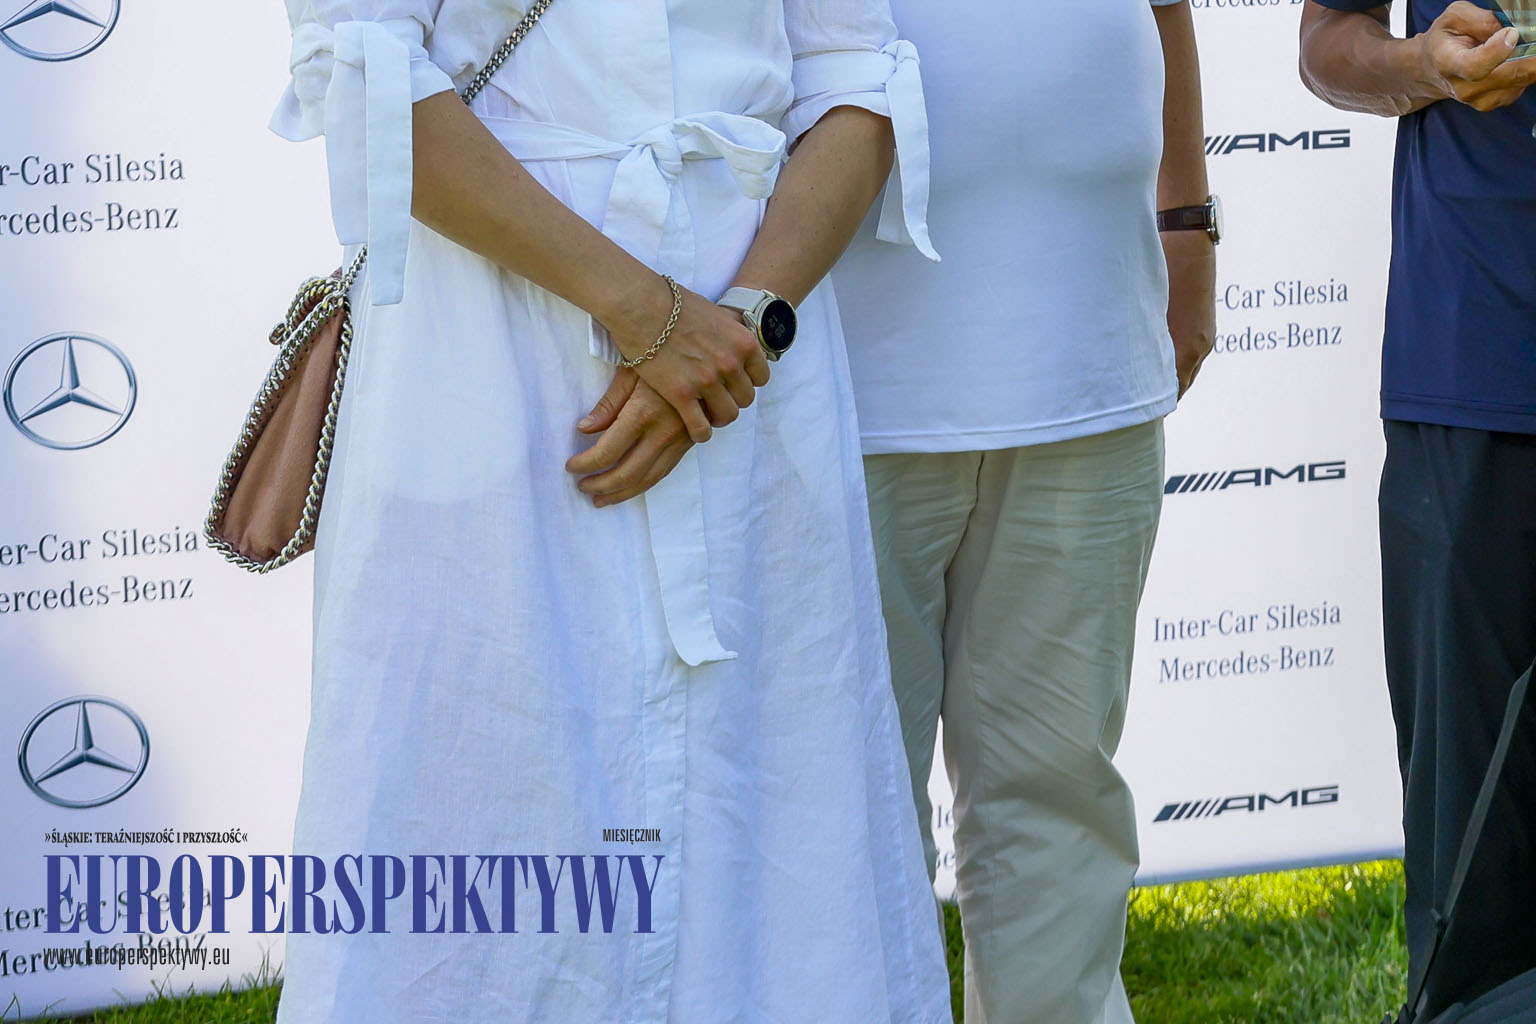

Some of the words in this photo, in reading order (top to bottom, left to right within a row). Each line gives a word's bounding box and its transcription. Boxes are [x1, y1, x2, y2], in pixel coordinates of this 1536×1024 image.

[1226, 129, 1350, 155] AMG
[84, 152, 186, 185] Silesia
[1273, 277, 1349, 307] Silesia
[1220, 461, 1345, 489] AMG
[101, 525, 200, 560] Silesia
[1153, 610, 1259, 643] Inter-Car
[1266, 600, 1341, 631] Silesia
[1159, 645, 1334, 683] Mercedes-Benz
[1215, 785, 1339, 816] AMG
